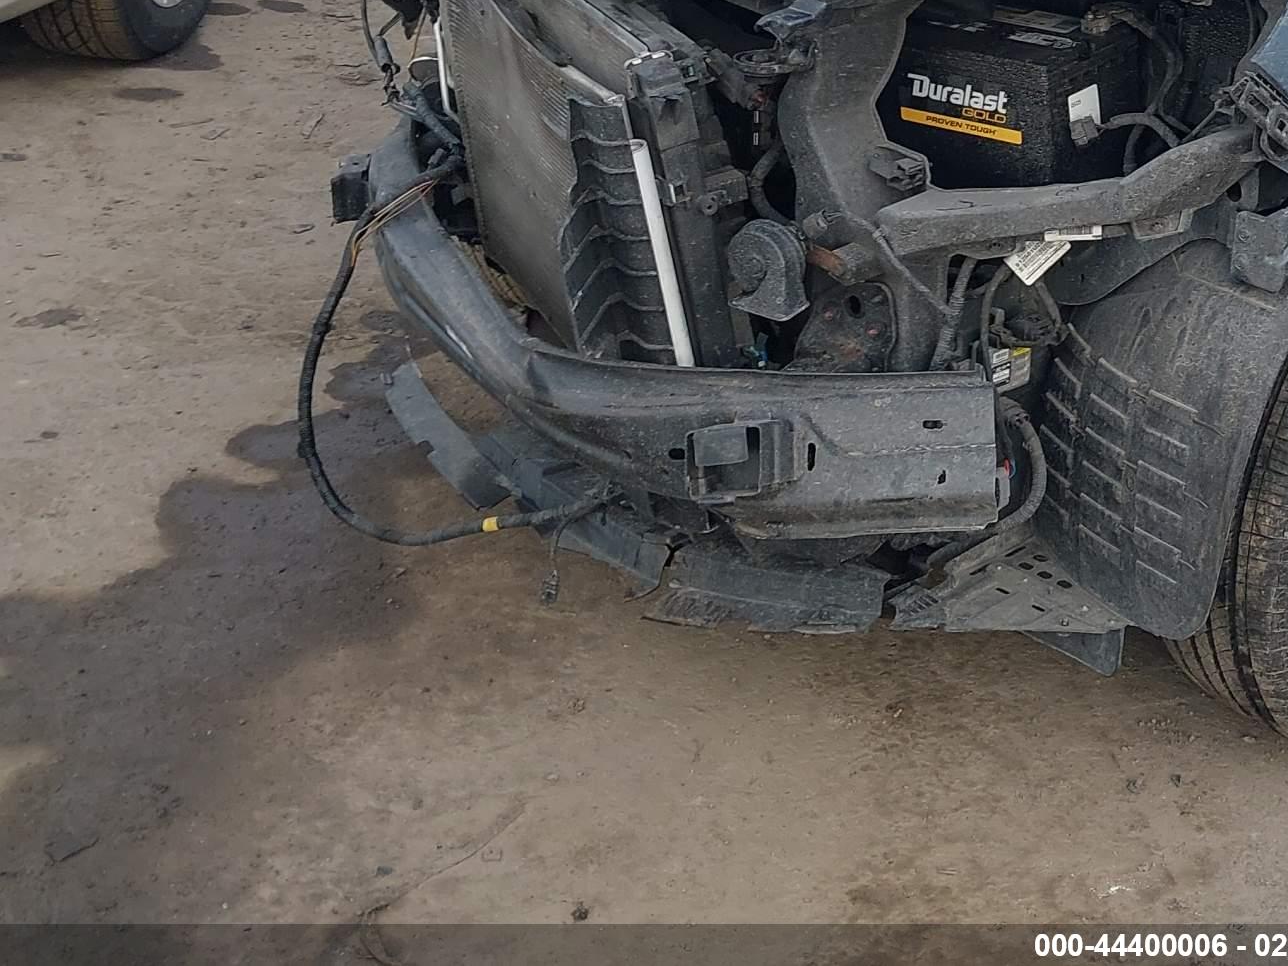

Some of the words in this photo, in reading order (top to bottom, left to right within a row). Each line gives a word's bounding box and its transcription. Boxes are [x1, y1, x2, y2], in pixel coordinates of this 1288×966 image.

[906, 72, 1009, 114] Duralast
[925, 115, 963, 129] PROVEN
[964, 122, 995, 136] TOUGH
[961, 107, 1007, 124] GOLD
